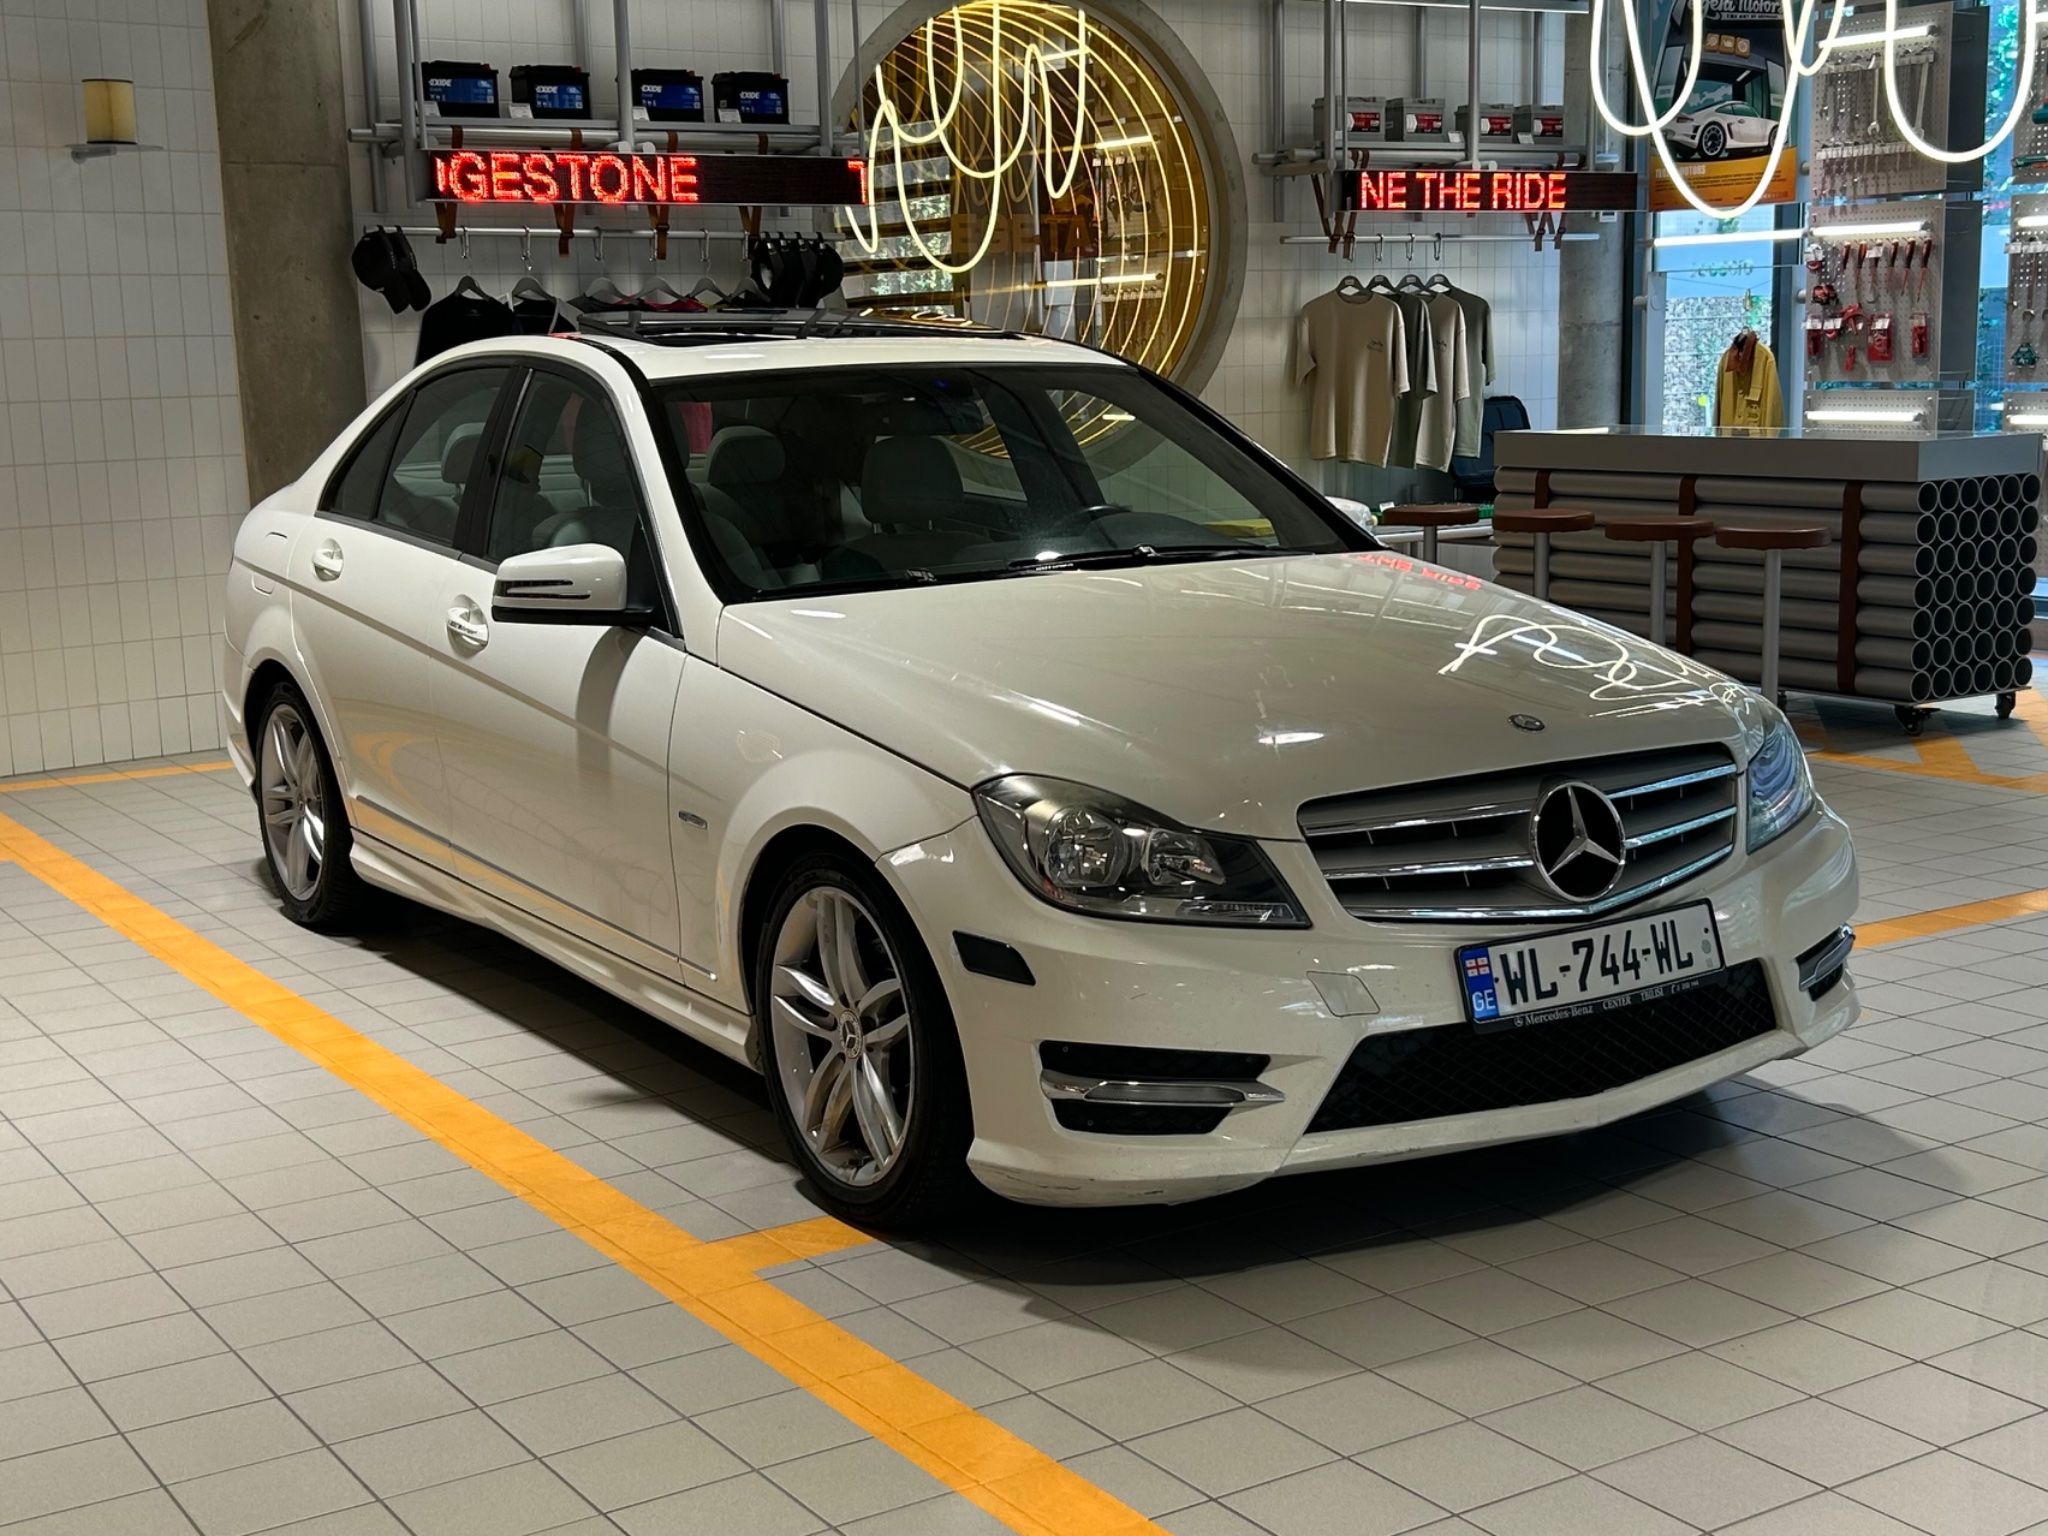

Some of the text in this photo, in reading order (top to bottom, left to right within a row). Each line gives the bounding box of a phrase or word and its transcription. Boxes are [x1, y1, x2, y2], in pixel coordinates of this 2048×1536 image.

[435, 151, 698, 202] GESTONE
[1359, 171, 1567, 209] NE THE RIDE
[1499, 919, 1694, 1006] WL-744-WL
[1472, 989, 1496, 1011] GE
[1524, 1004, 1594, 1026] Mercedes-Benz
[1602, 994, 1633, 1010] CENTER
